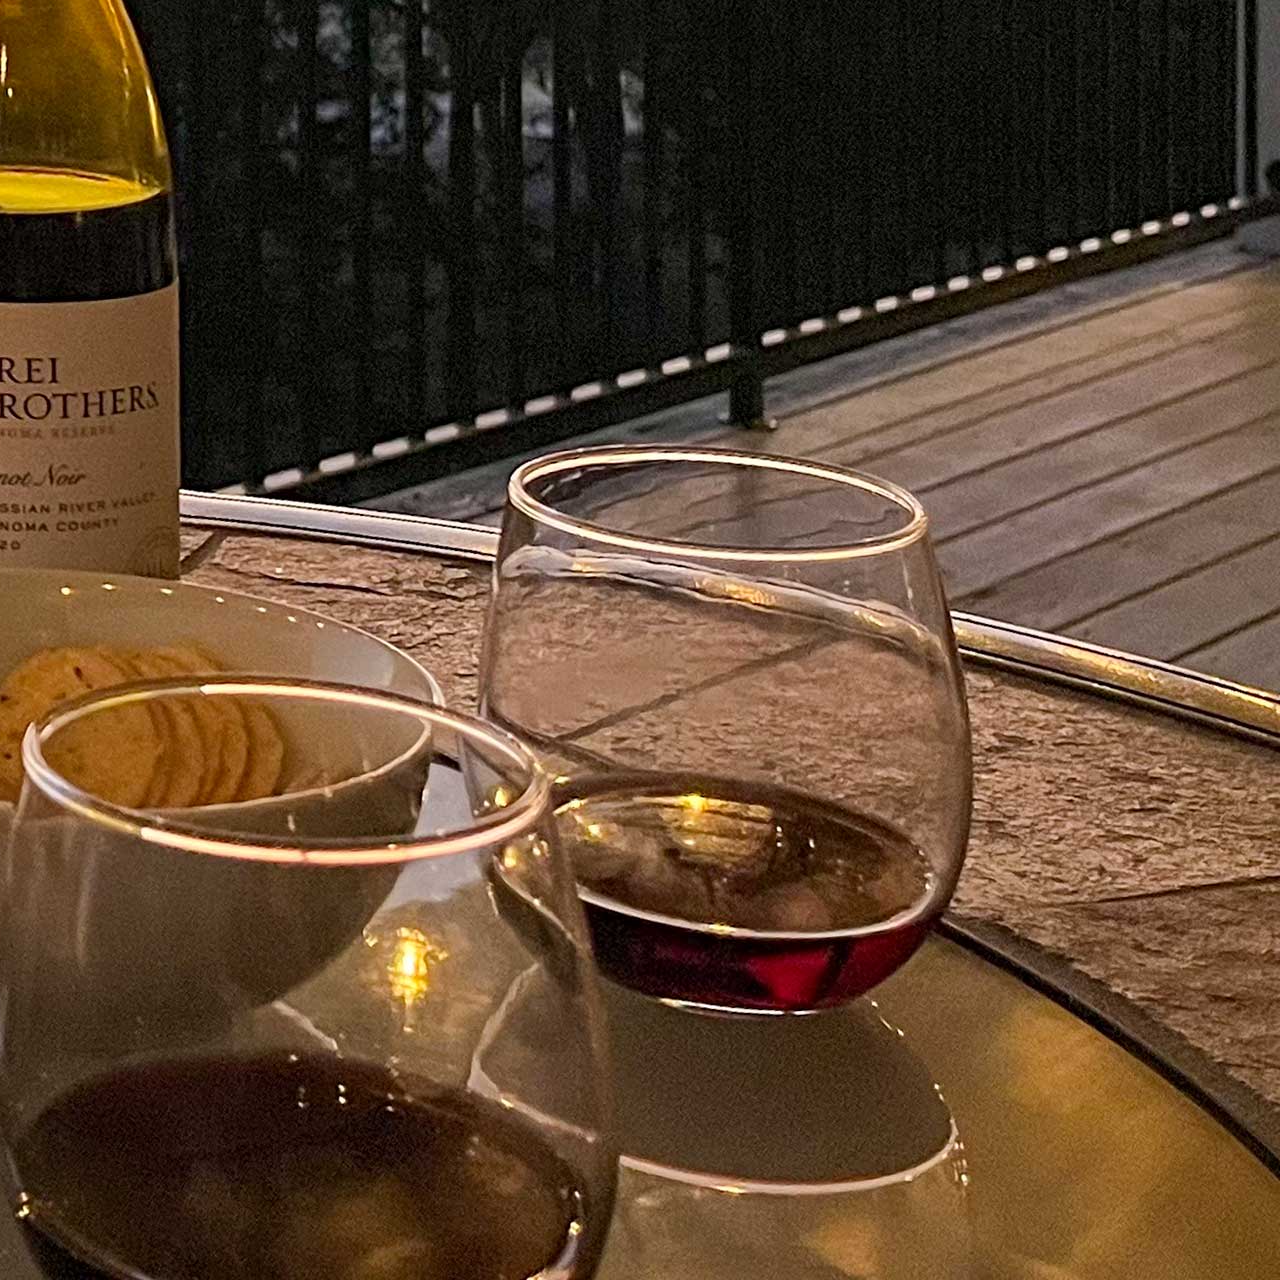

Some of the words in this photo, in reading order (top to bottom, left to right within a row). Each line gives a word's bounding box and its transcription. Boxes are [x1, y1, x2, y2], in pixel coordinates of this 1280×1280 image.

[34, 463, 86, 487] Noir
[58, 501, 106, 514] RIVER
[55, 517, 119, 532] COUNTY
